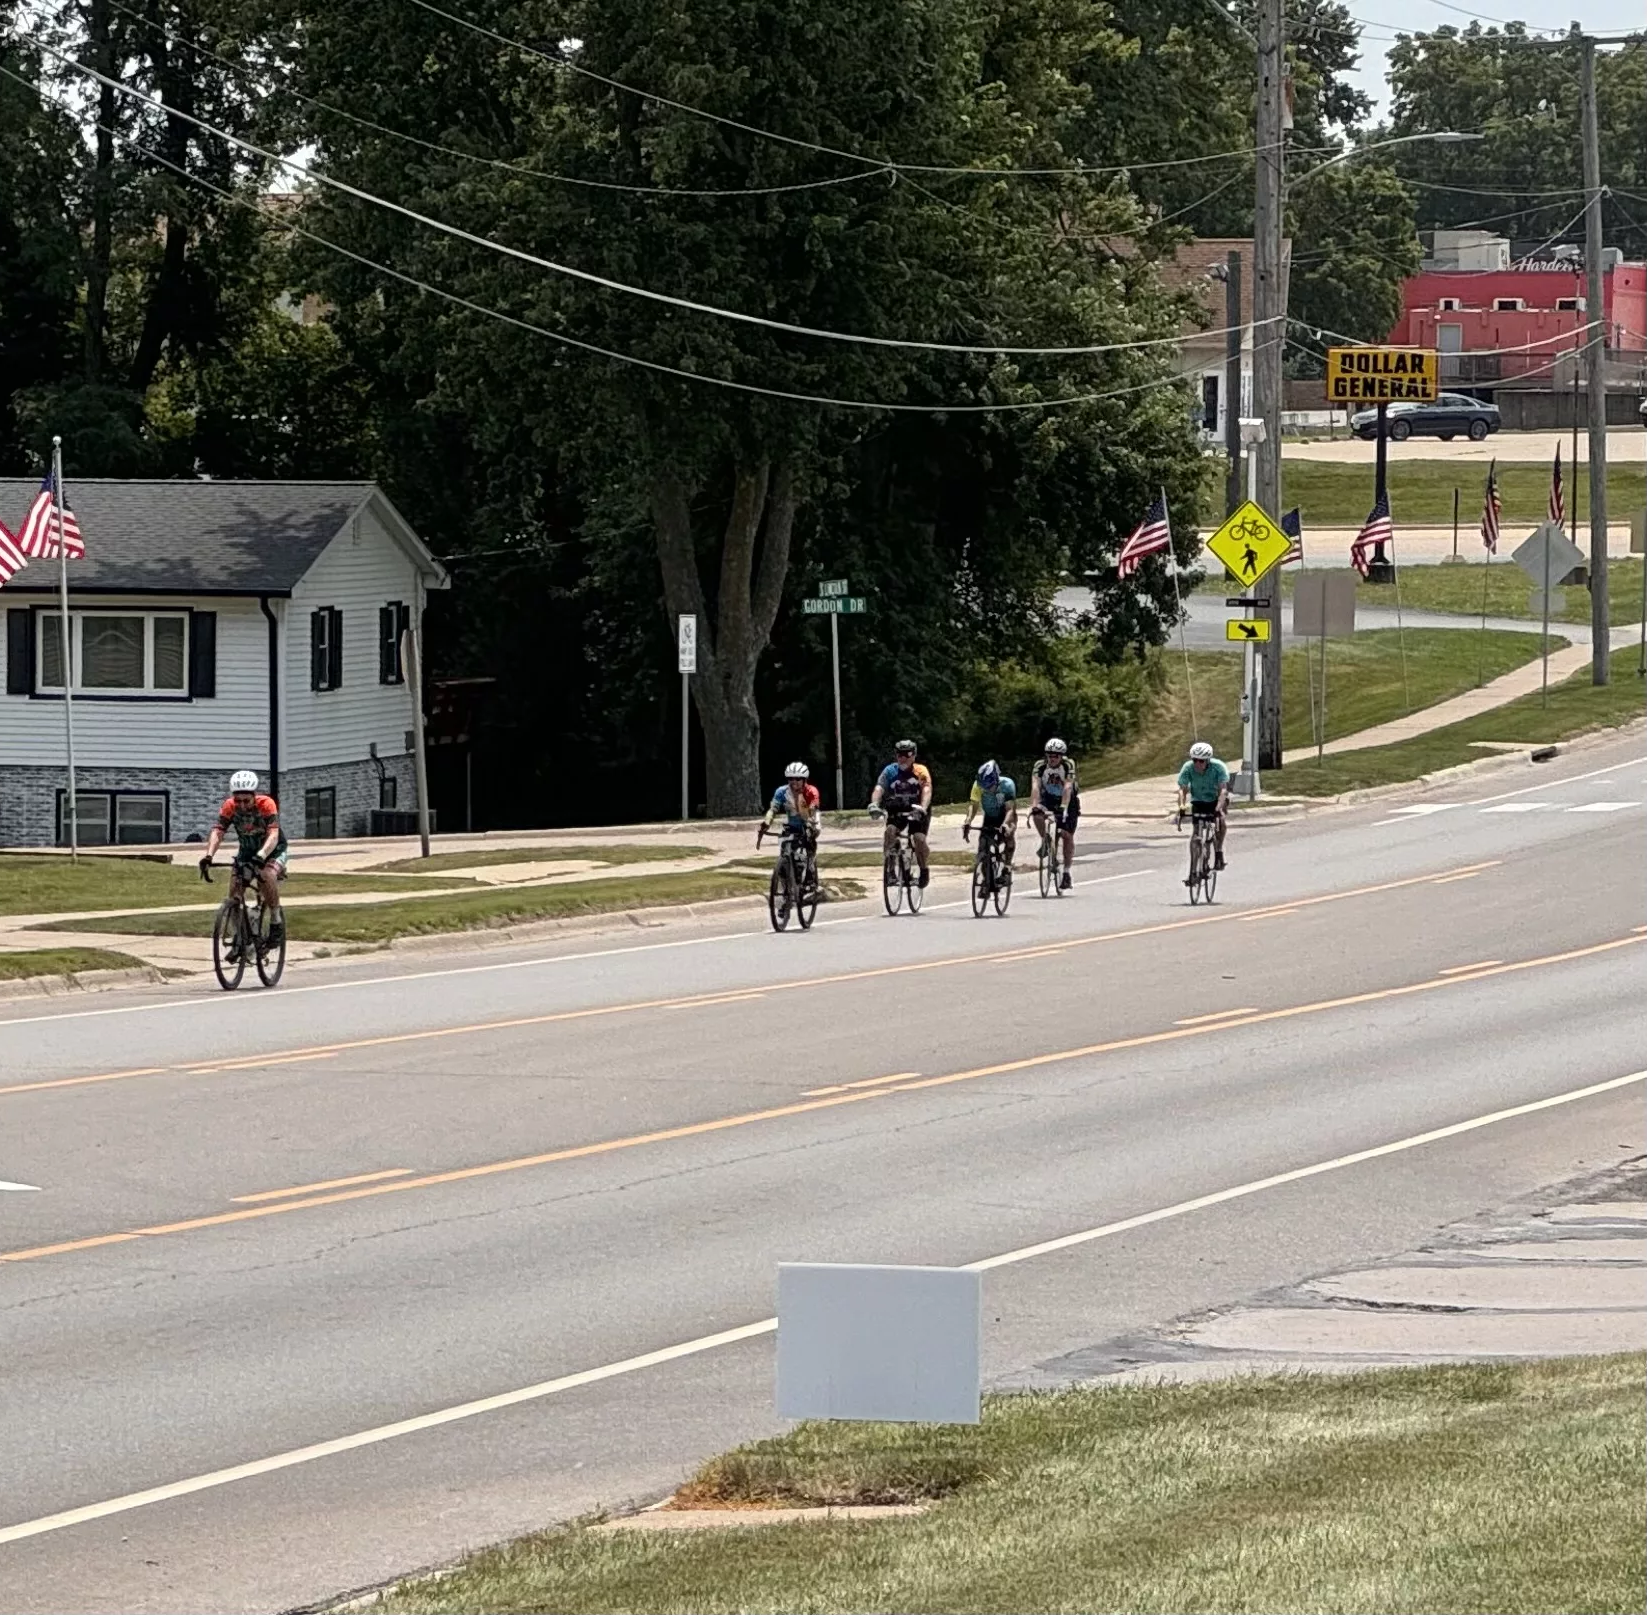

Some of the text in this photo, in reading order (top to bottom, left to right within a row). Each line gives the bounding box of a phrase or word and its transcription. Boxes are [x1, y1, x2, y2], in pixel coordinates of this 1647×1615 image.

[1340, 353, 1425, 374] DOLLAR
[1334, 377, 1432, 397] GENERAL
[804, 598, 864, 614] GORDON DR
